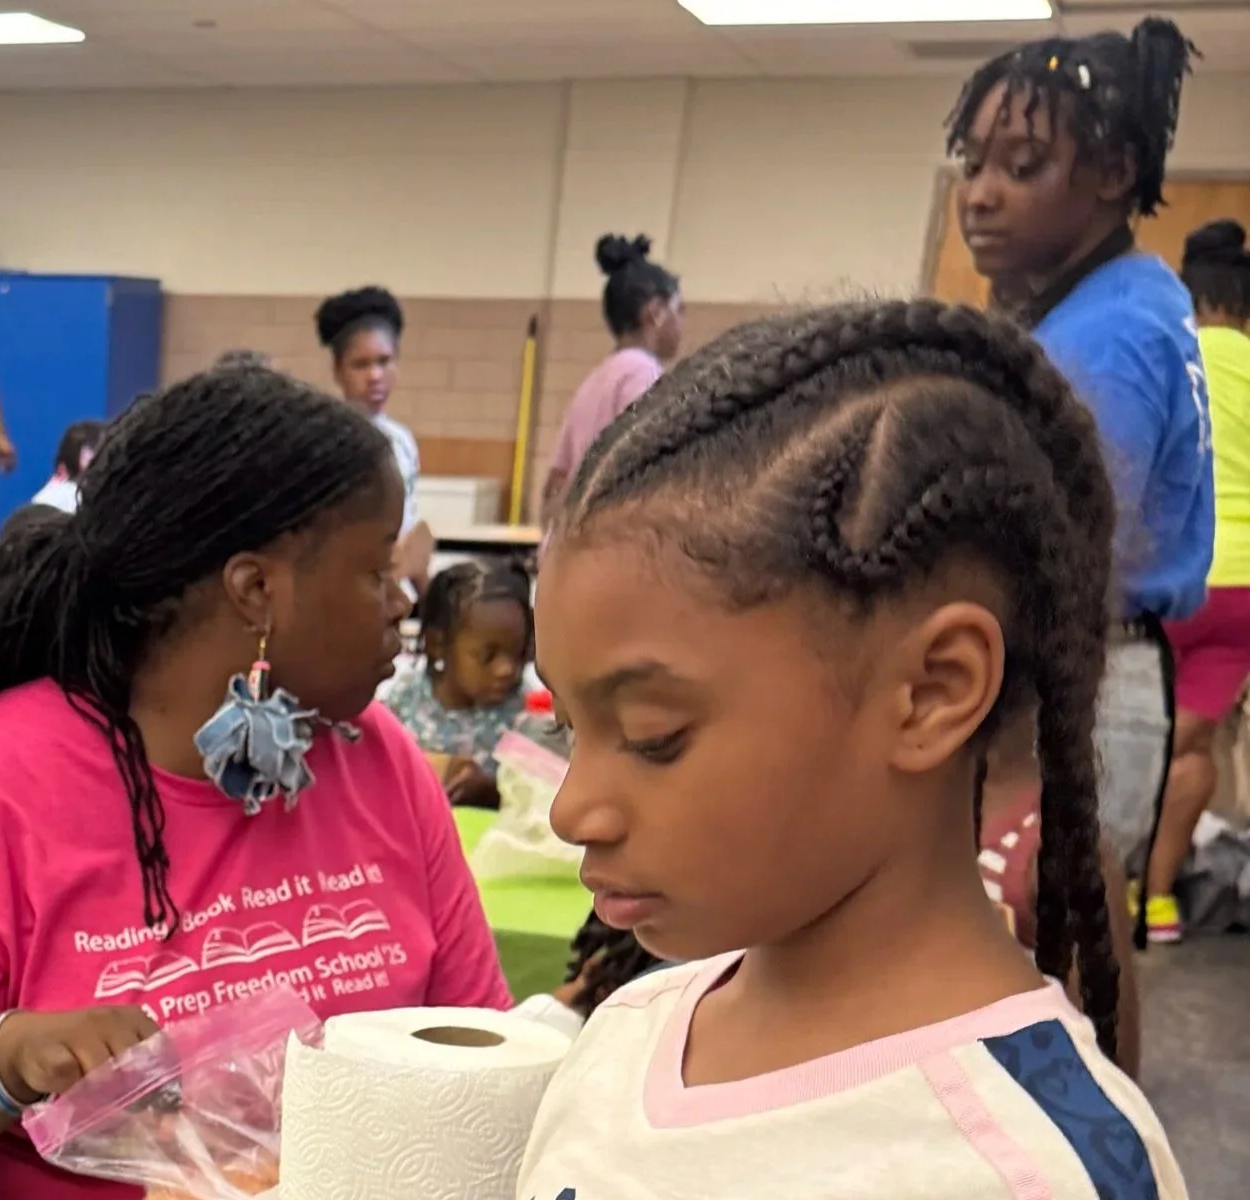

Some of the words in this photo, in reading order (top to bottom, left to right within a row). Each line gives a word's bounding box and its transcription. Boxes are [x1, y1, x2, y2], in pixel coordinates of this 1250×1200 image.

[74, 921, 168, 953] Reading
[241, 877, 292, 909] Read
[293, 873, 314, 896] it
[159, 990, 210, 1018] Prep
[213, 966, 313, 1004] Freedom
[314, 944, 385, 980] School
[331, 972, 375, 997] Read
